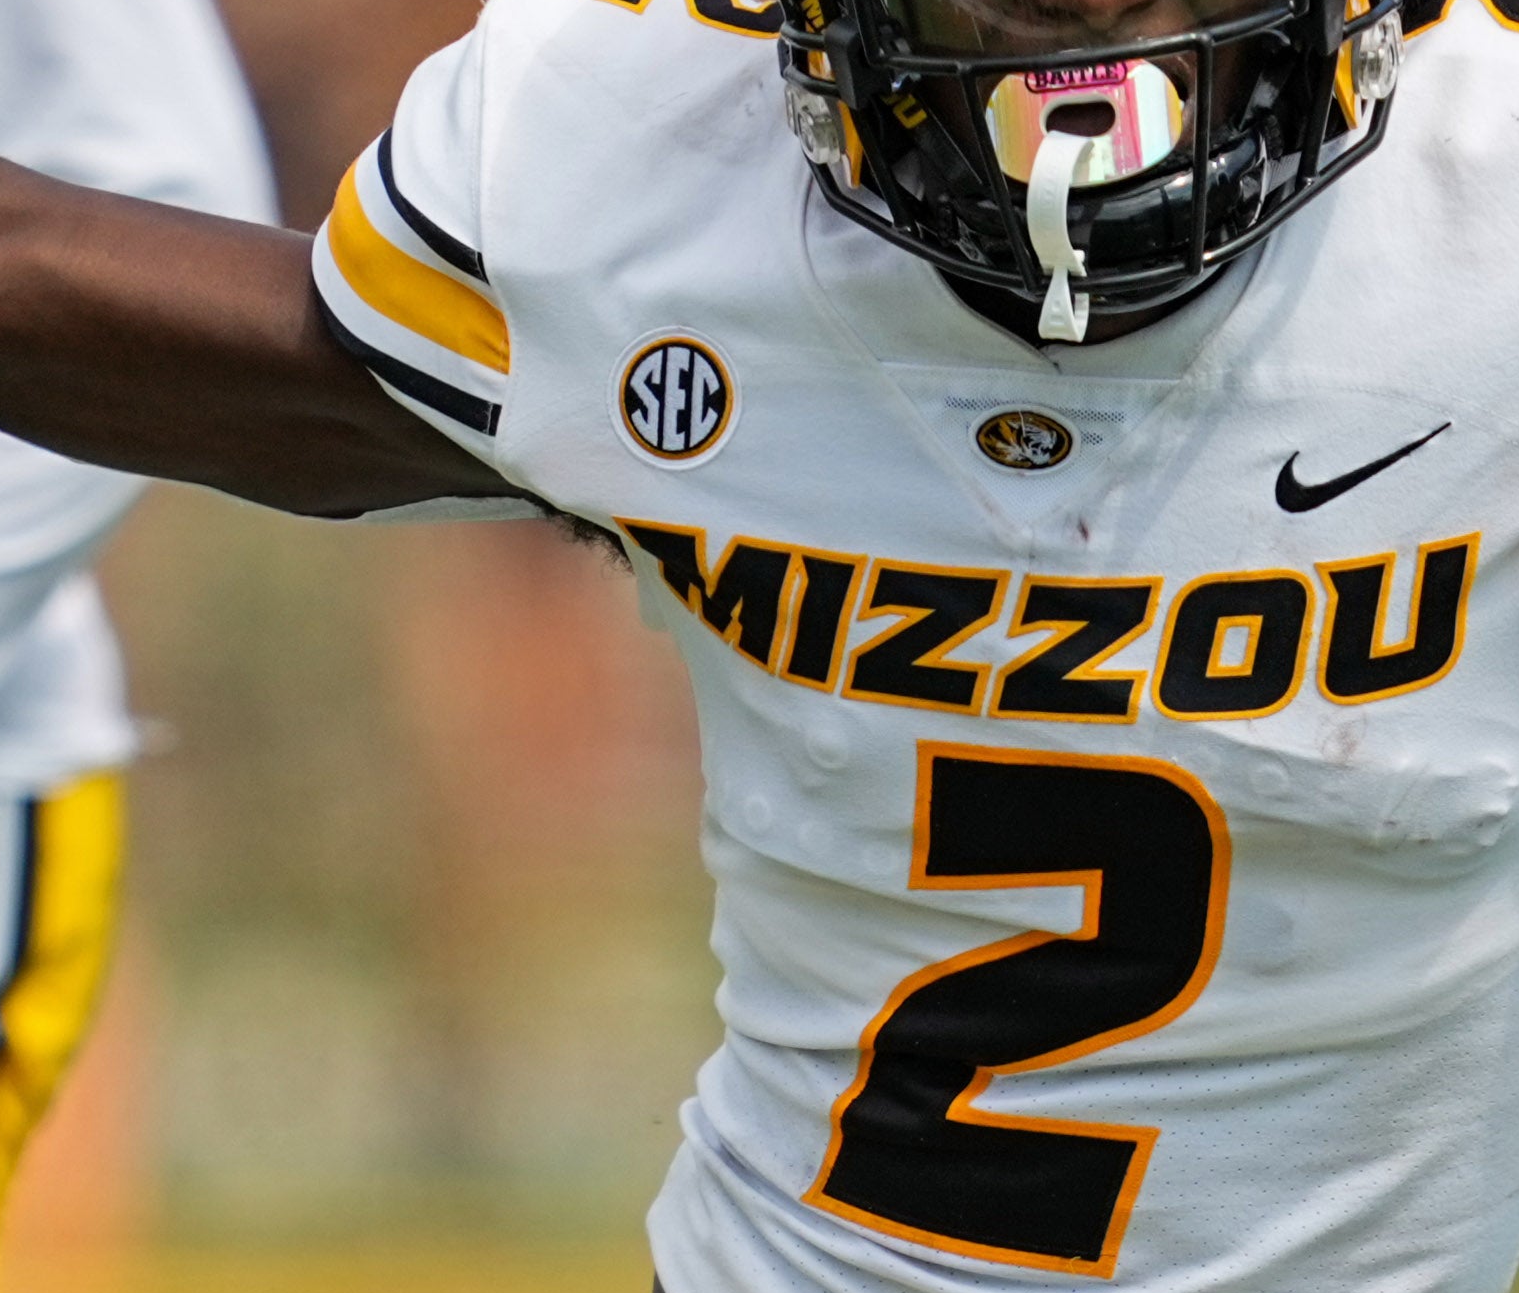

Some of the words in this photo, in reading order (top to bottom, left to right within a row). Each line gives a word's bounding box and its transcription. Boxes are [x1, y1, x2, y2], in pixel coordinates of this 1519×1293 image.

[1034, 62, 1122, 89] BATTLE
[627, 343, 723, 454] SEC
[613, 514, 1479, 724] MIZZOU
[800, 738, 1233, 1280] 2
